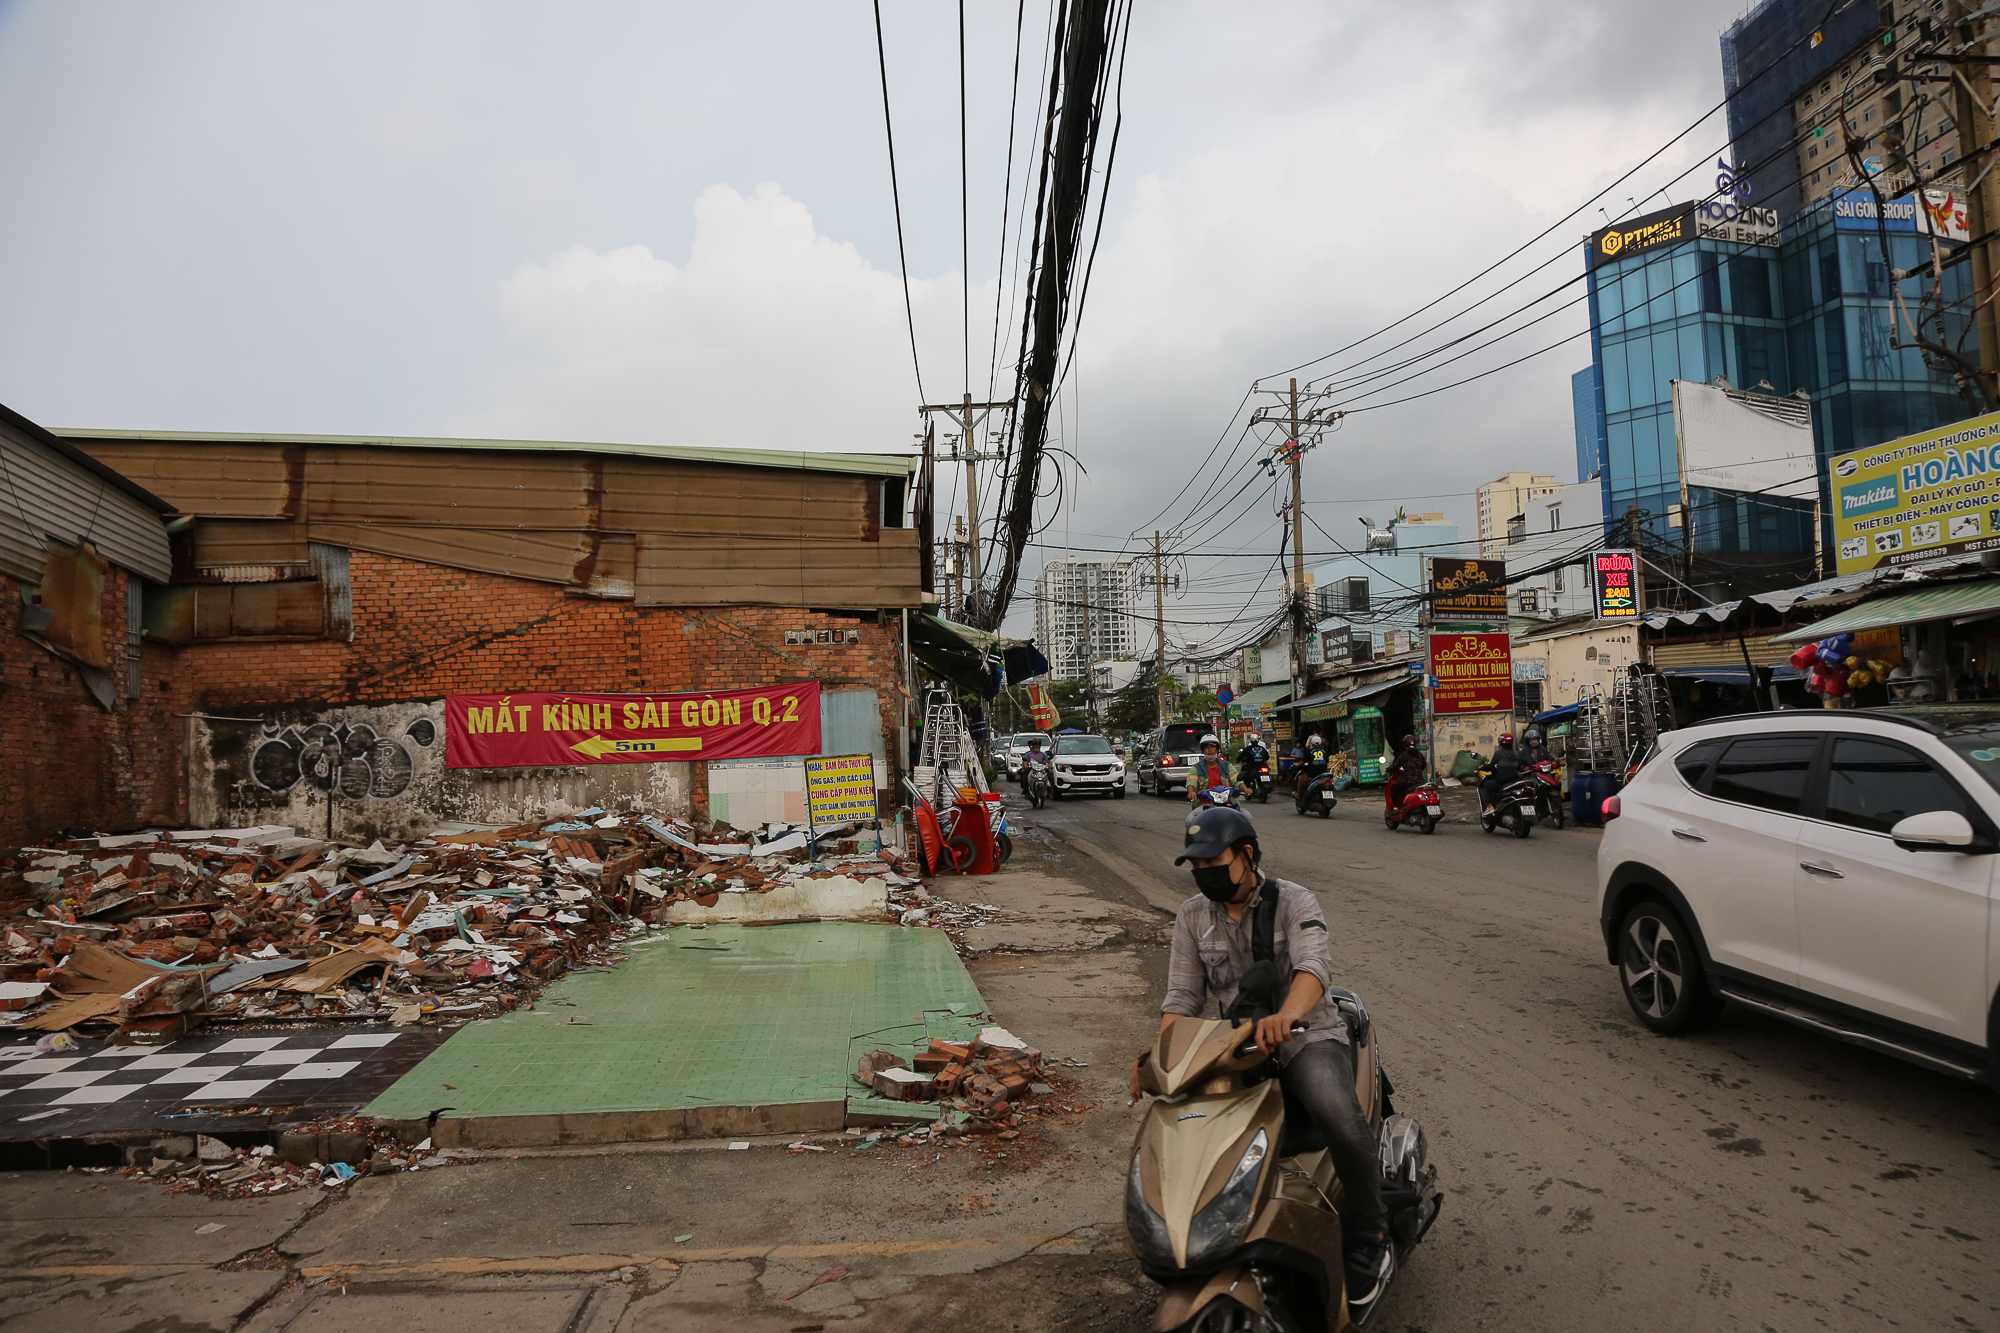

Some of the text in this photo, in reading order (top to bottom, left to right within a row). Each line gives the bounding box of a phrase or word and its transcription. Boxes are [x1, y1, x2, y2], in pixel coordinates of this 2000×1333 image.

[1835, 196, 1854, 218] SÀI
[1855, 196, 1878, 219] GÒN
[1700, 224, 1779, 246] Real Estate
[1863, 453, 1891, 469] CÔNG
[1893, 449, 1906, 461] TY
[1906, 440, 1937, 458] TNHH
[1938, 426, 1986, 448] THƯƠNG
[1843, 486, 1896, 510] makita
[1910, 494, 1930, 507] ĐẠI
[1932, 488, 1944, 501] LÝ
[1946, 484, 1961, 498] KÝ
[1853, 516, 1882, 532] THIẾT
[1883, 515, 1894, 528] BỊ
[1895, 508, 1921, 524] ĐIỆN
[1955, 495, 1989, 510] CÔNG
[1964, 541, 1981, 551] MST
[1597, 553, 1633, 571] RỬA
[1890, 555, 1900, 564] ĐT
[1605, 573, 1628, 586] XE
[1490, 591, 1508, 606] BÌNH
[1605, 587, 1630, 598] 24H
[1456, 662, 1477, 678] RƯỢU
[1479, 661, 1490, 675] TƯ
[1491, 660, 1509, 675] BÌNH
[468, 694, 799, 734] MẮT KÍNH SÀI GÒN Q.2
[615, 741, 656, 752] 5m
[1313, 750, 1323, 758] 10
[847, 773, 858, 782] CÁC
[811, 784, 874, 799] CUNG CẤP PHỤ KIỆN
[837, 813, 847, 821] GAS
